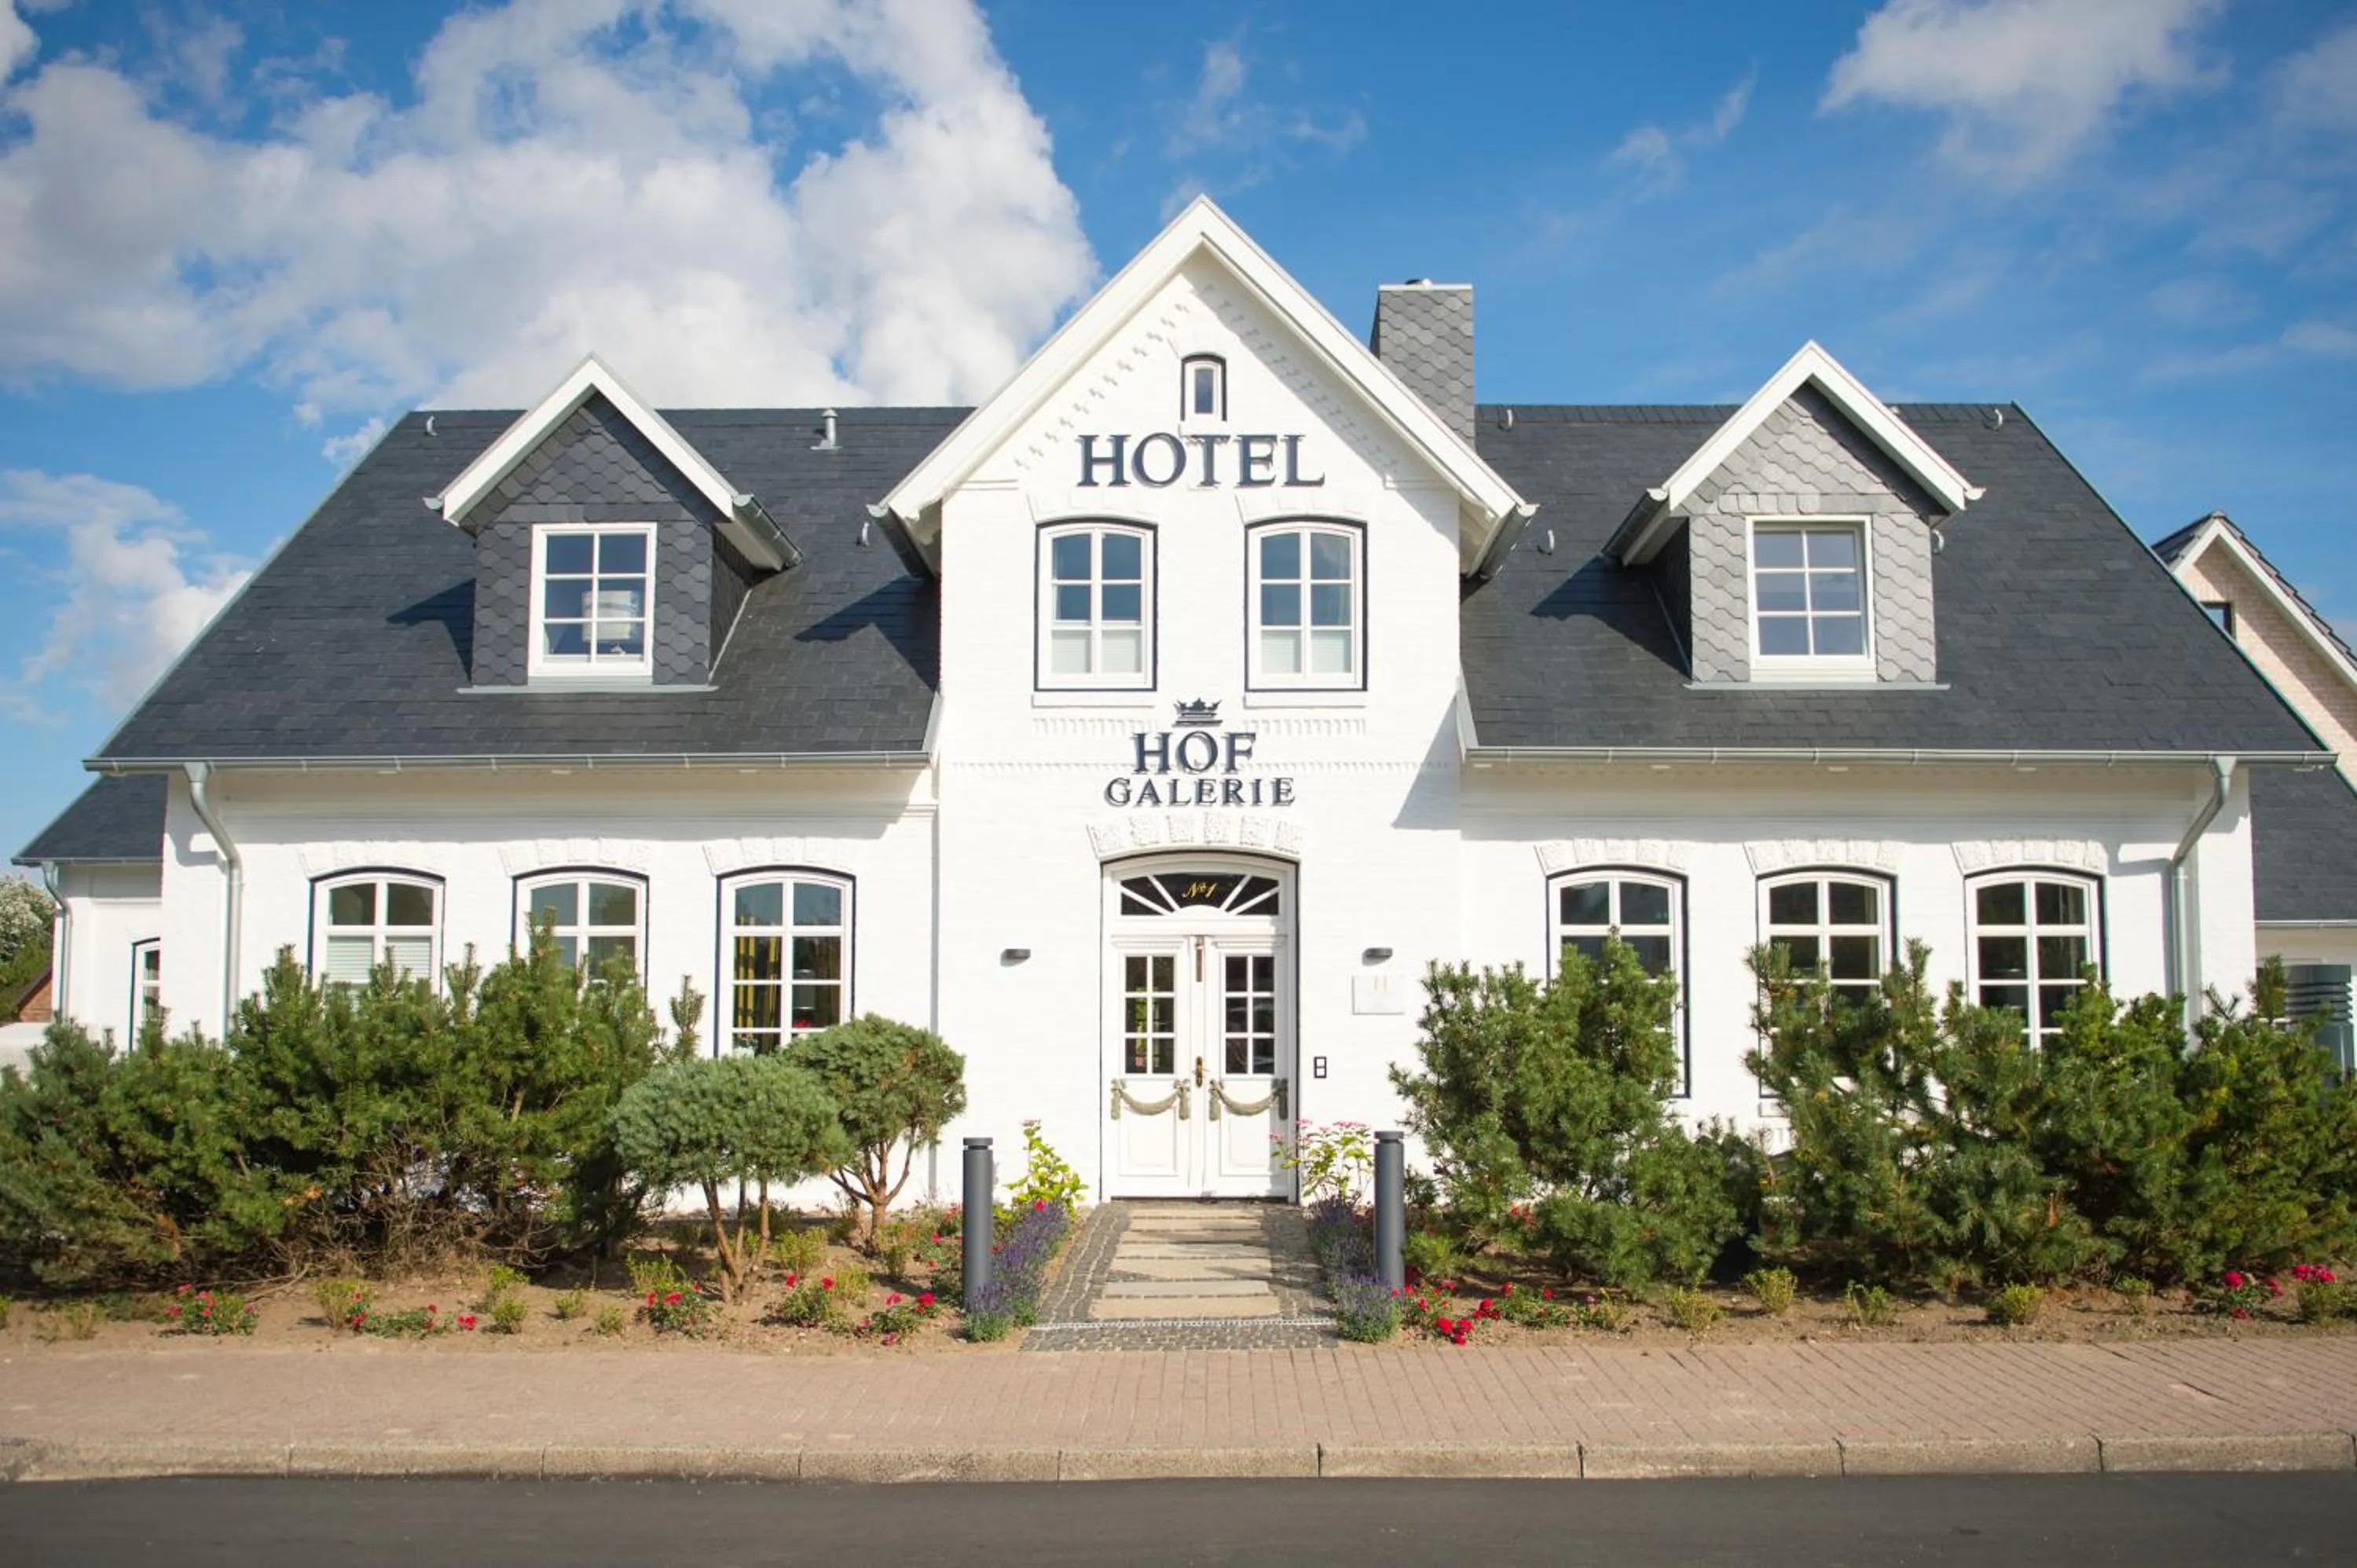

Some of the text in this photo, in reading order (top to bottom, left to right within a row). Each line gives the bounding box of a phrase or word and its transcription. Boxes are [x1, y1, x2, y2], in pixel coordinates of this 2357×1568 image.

[1077, 432, 1325, 488] HOTEL
[1131, 730, 1256, 775] HOF
[1104, 777, 1295, 807] GALERIE
